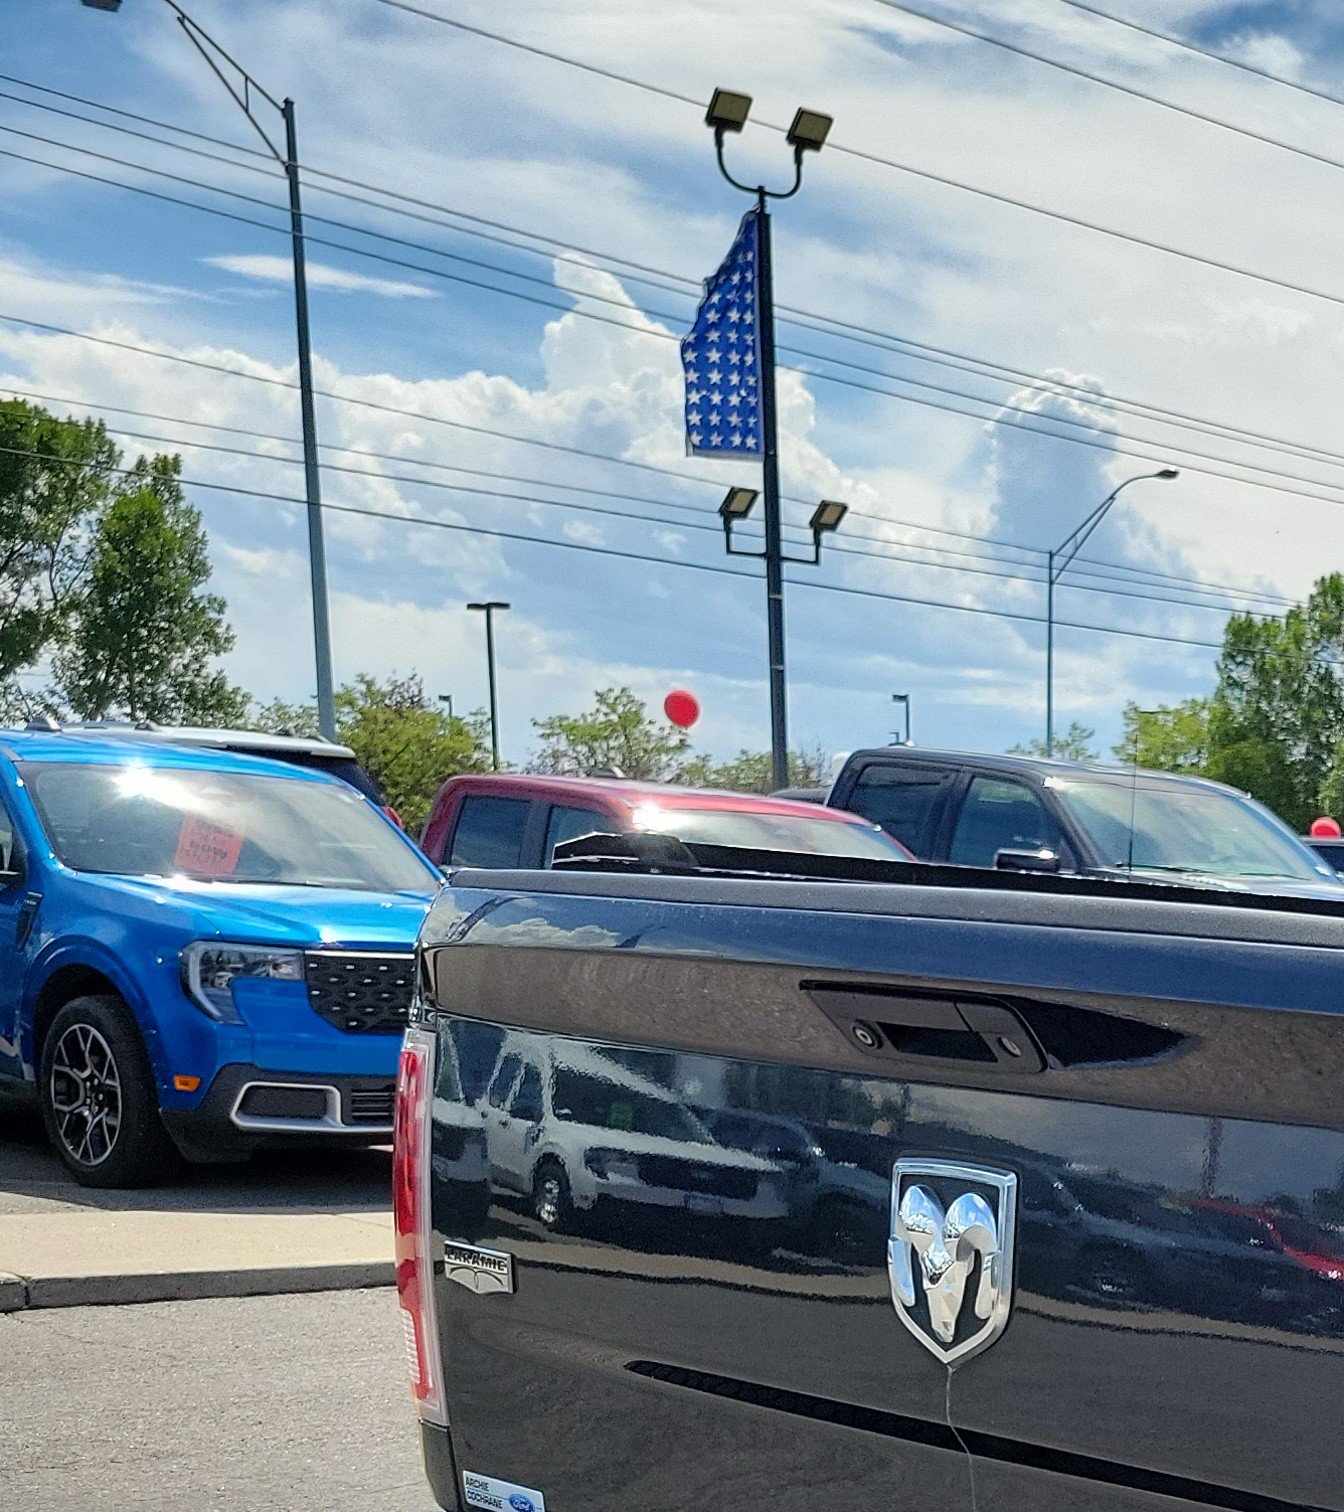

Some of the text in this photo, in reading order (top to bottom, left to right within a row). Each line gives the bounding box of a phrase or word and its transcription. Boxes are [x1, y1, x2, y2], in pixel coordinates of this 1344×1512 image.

[445, 1245, 507, 1272] LARAMIE
[466, 1476, 490, 1492] ARCHIE
[467, 1490, 503, 1509] COCHRANE
